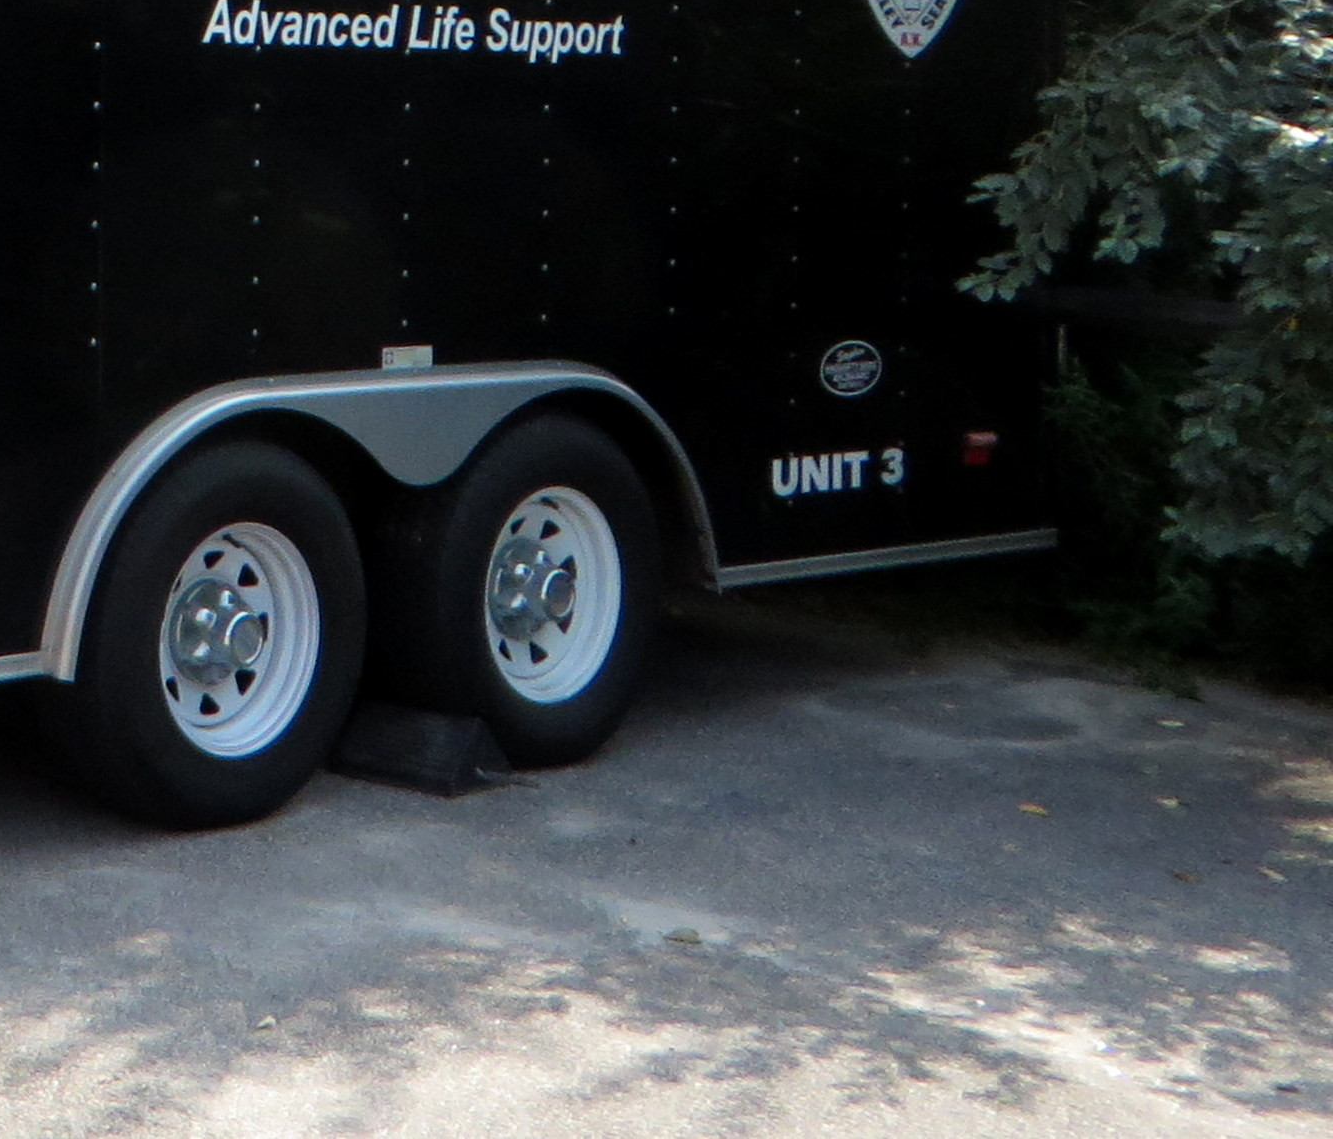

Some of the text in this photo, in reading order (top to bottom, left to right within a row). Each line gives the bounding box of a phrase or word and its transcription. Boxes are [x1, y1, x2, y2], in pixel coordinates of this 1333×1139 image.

[408, 3, 477, 51] Life
[485, 7, 625, 64] Support
[771, 447, 905, 498] UNIT 3
